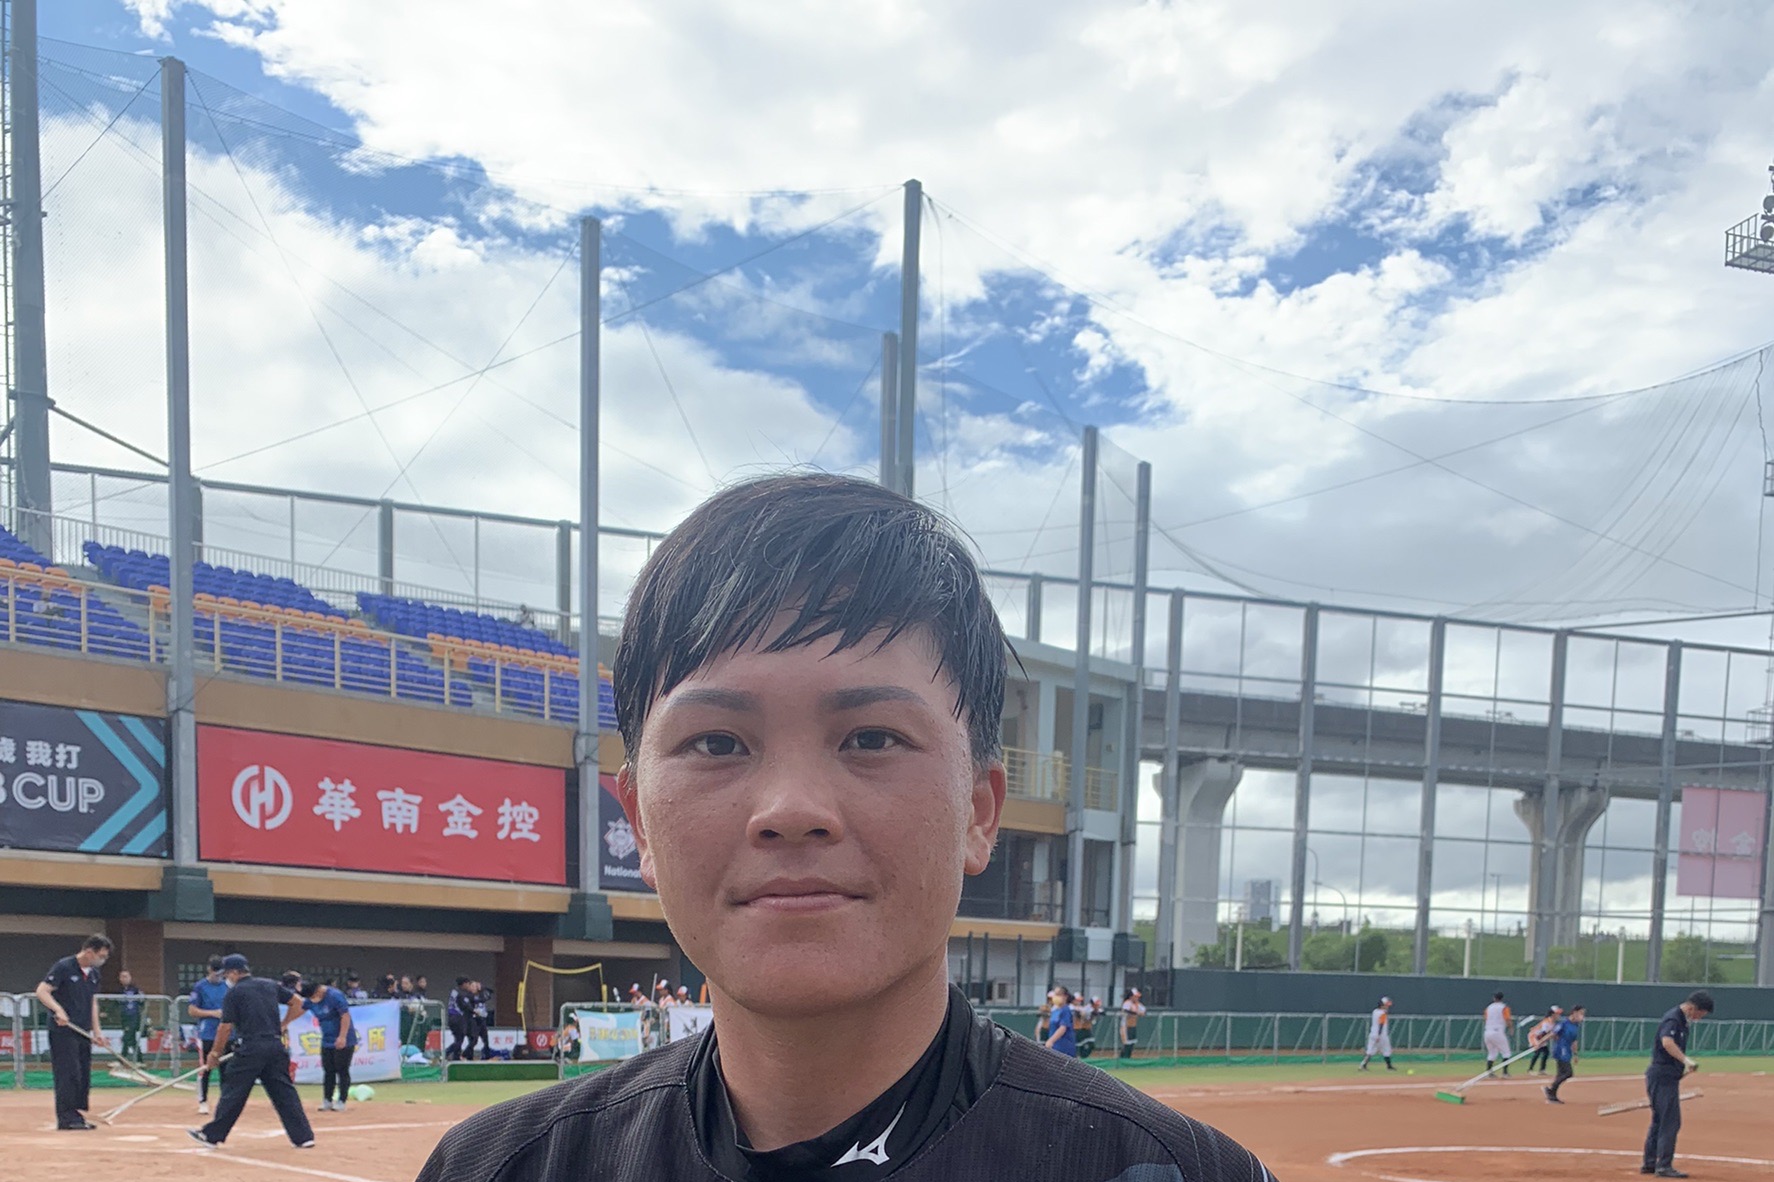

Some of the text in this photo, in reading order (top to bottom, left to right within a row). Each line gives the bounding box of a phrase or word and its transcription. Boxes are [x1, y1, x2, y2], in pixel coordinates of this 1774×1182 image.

[12, 772, 105, 813] CUP
[312, 776, 541, 842] 華南金控
